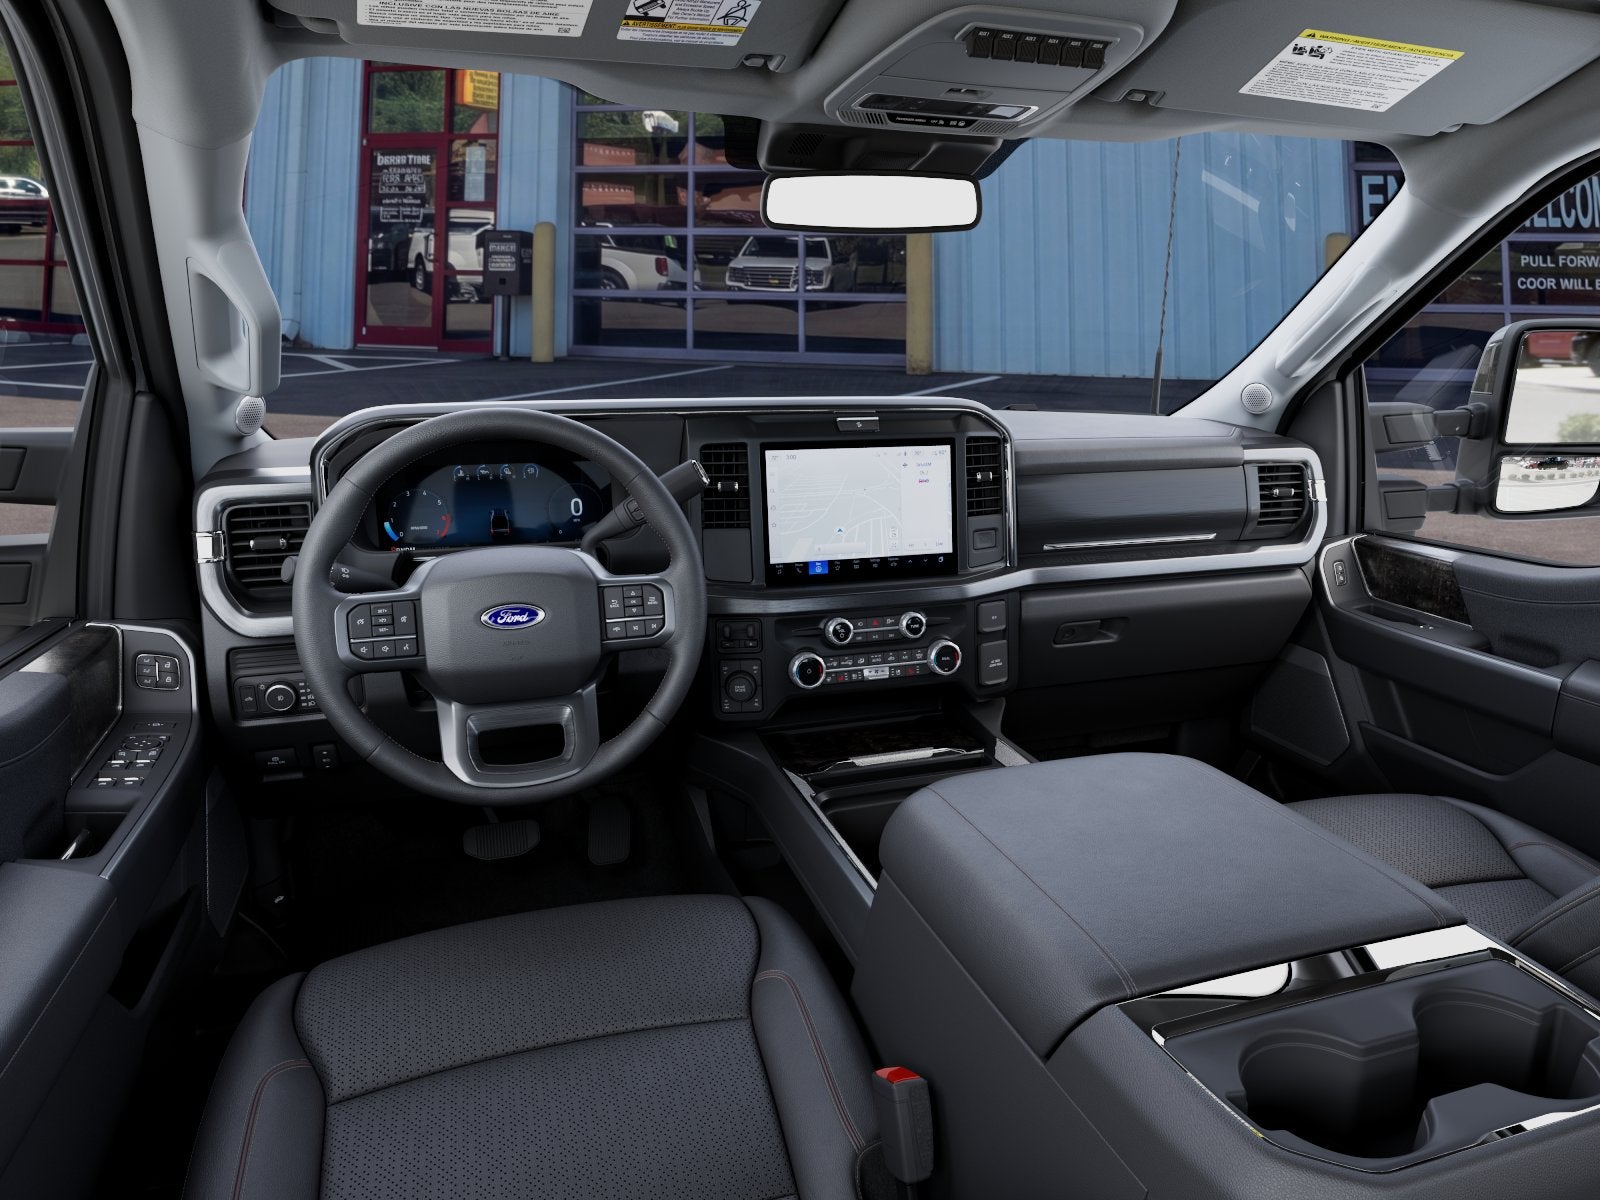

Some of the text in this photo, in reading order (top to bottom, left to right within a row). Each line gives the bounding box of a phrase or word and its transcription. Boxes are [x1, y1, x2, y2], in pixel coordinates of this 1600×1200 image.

[1521, 255, 1600, 268] PULL FORW
[1560, 277, 1593, 290] WILL
[571, 498, 583, 516] 0
[496, 609, 529, 624] Ford
